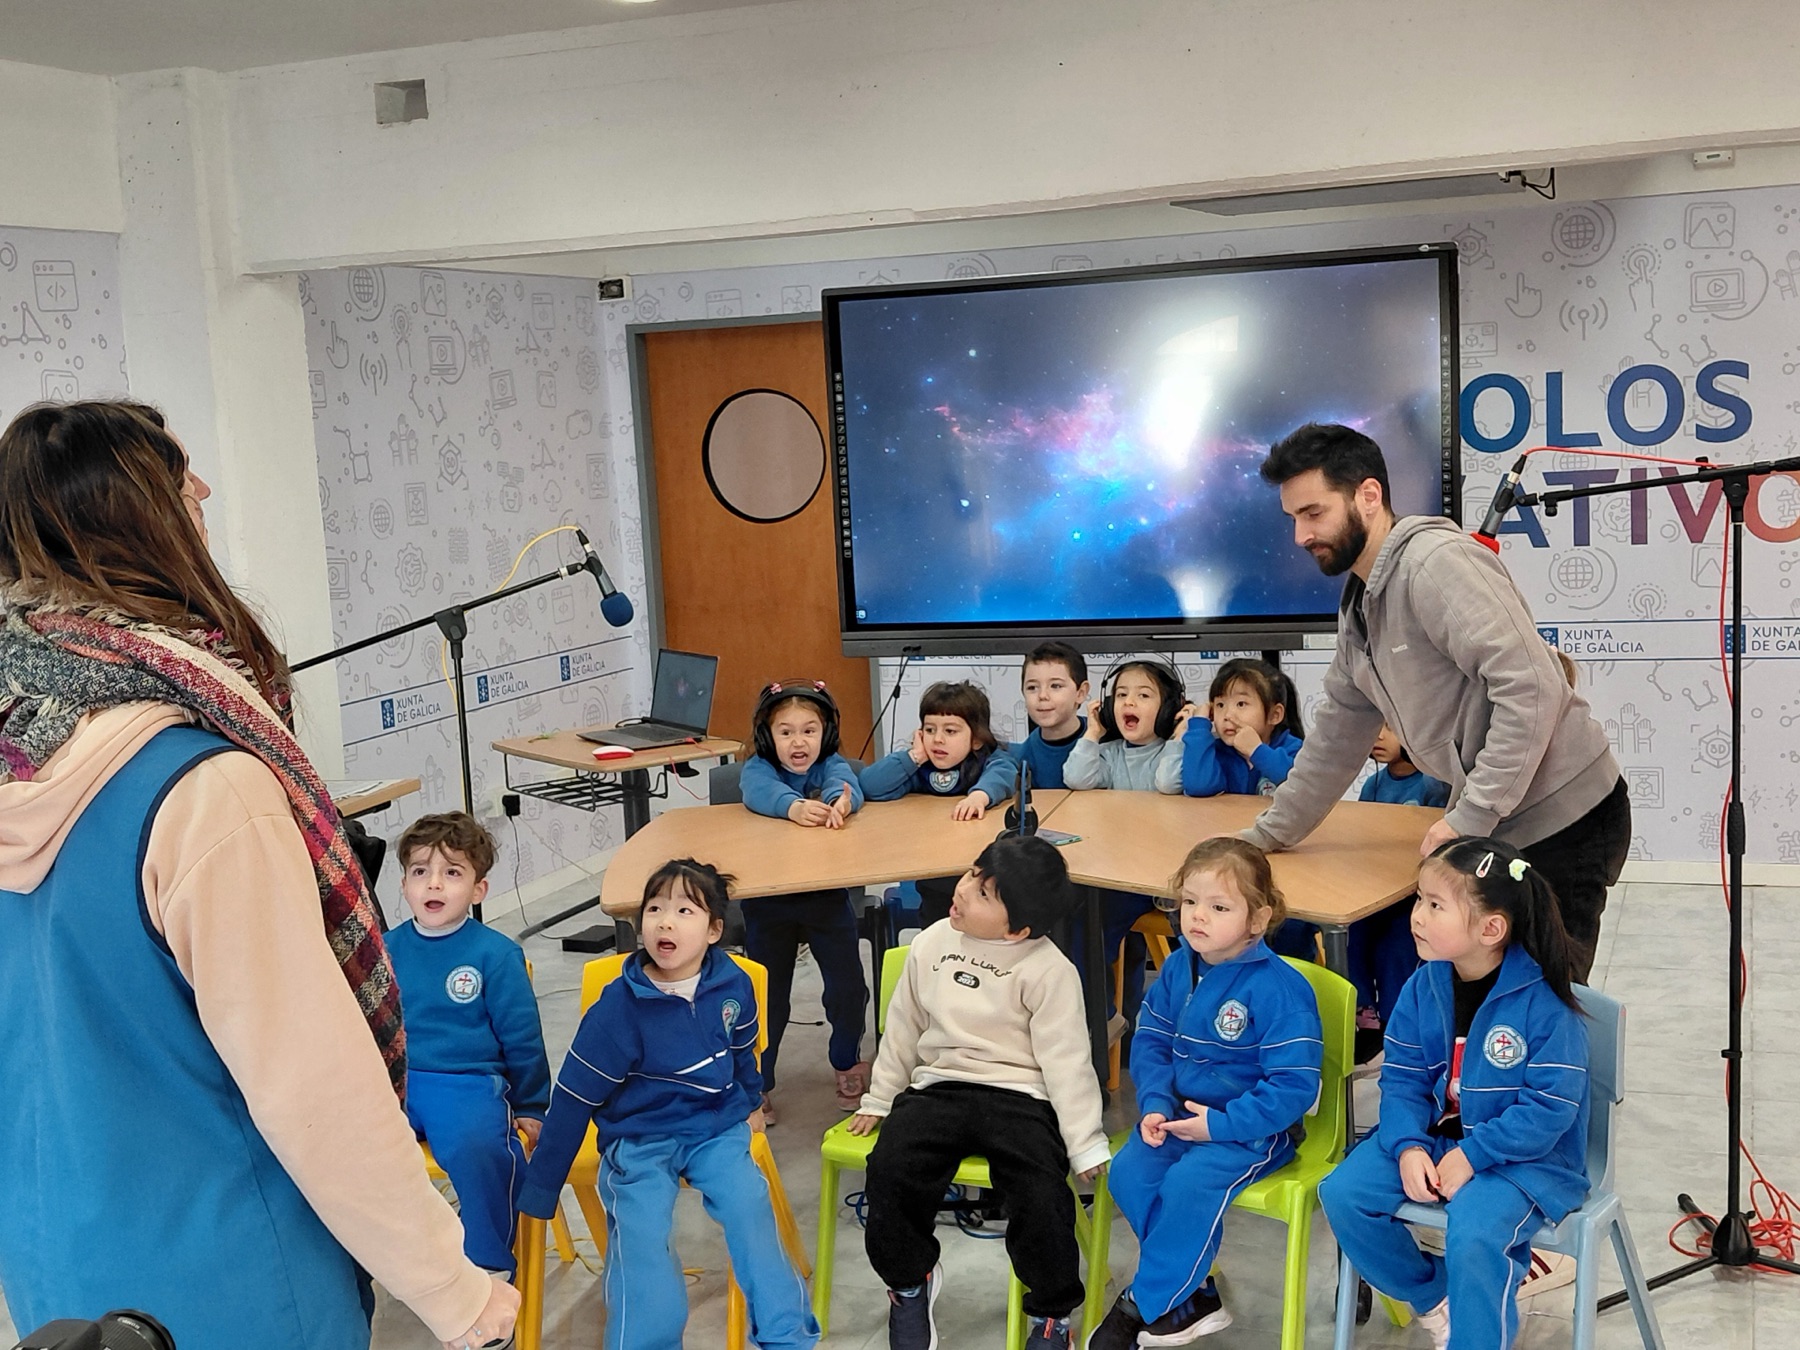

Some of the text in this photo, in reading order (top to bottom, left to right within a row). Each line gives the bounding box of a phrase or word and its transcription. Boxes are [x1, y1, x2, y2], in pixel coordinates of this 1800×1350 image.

[1461, 466, 1800, 548] ATIVO
[1564, 629, 1613, 640] XUNTA
[1752, 626, 1800, 638] XUNTA
[1564, 642, 1645, 653] DE GALICIA
[1751, 640, 1770, 651] DE
[571, 652, 592, 665] XUNTA
[572, 660, 606, 677] DE GALICIA
[490, 671, 514, 685] XUNTA
[491, 680, 529, 698] DE GALICIA
[396, 694, 424, 710] XUNTA
[397, 702, 441, 723] DE GALICIA
